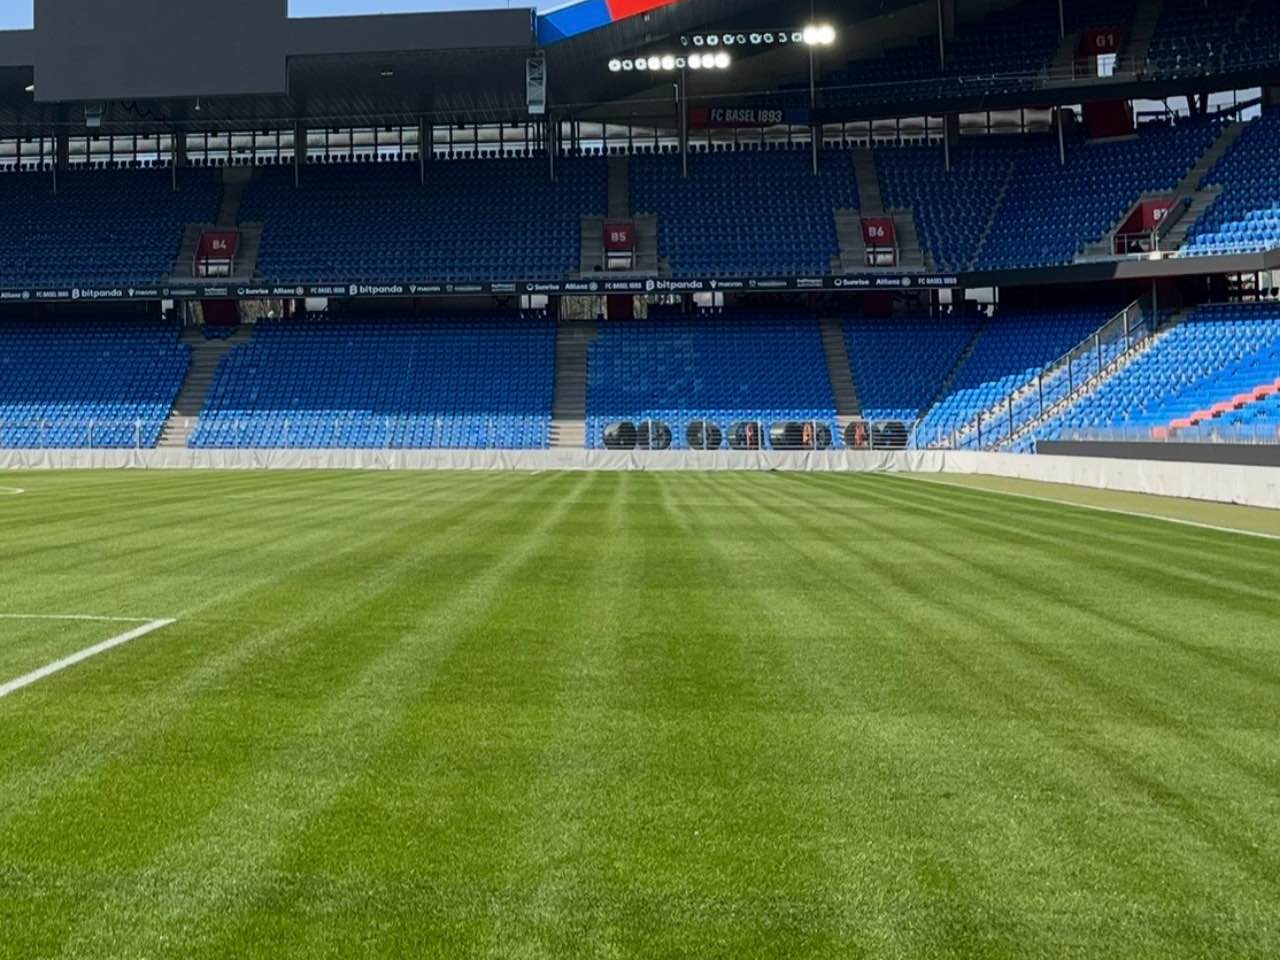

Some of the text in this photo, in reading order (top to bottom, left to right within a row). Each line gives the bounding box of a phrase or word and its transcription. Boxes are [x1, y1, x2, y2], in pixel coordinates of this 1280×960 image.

[1096, 34, 1114, 47] G1
[711, 108, 782, 122] FC BASEL 1893
[611, 232, 626, 242] B5
[868, 226, 884, 238] B6
[212, 239, 227, 250] B4
[359, 284, 403, 295] bitpanda
[656, 280, 703, 290] bitpanda
[81, 288, 123, 298] bitpanda
